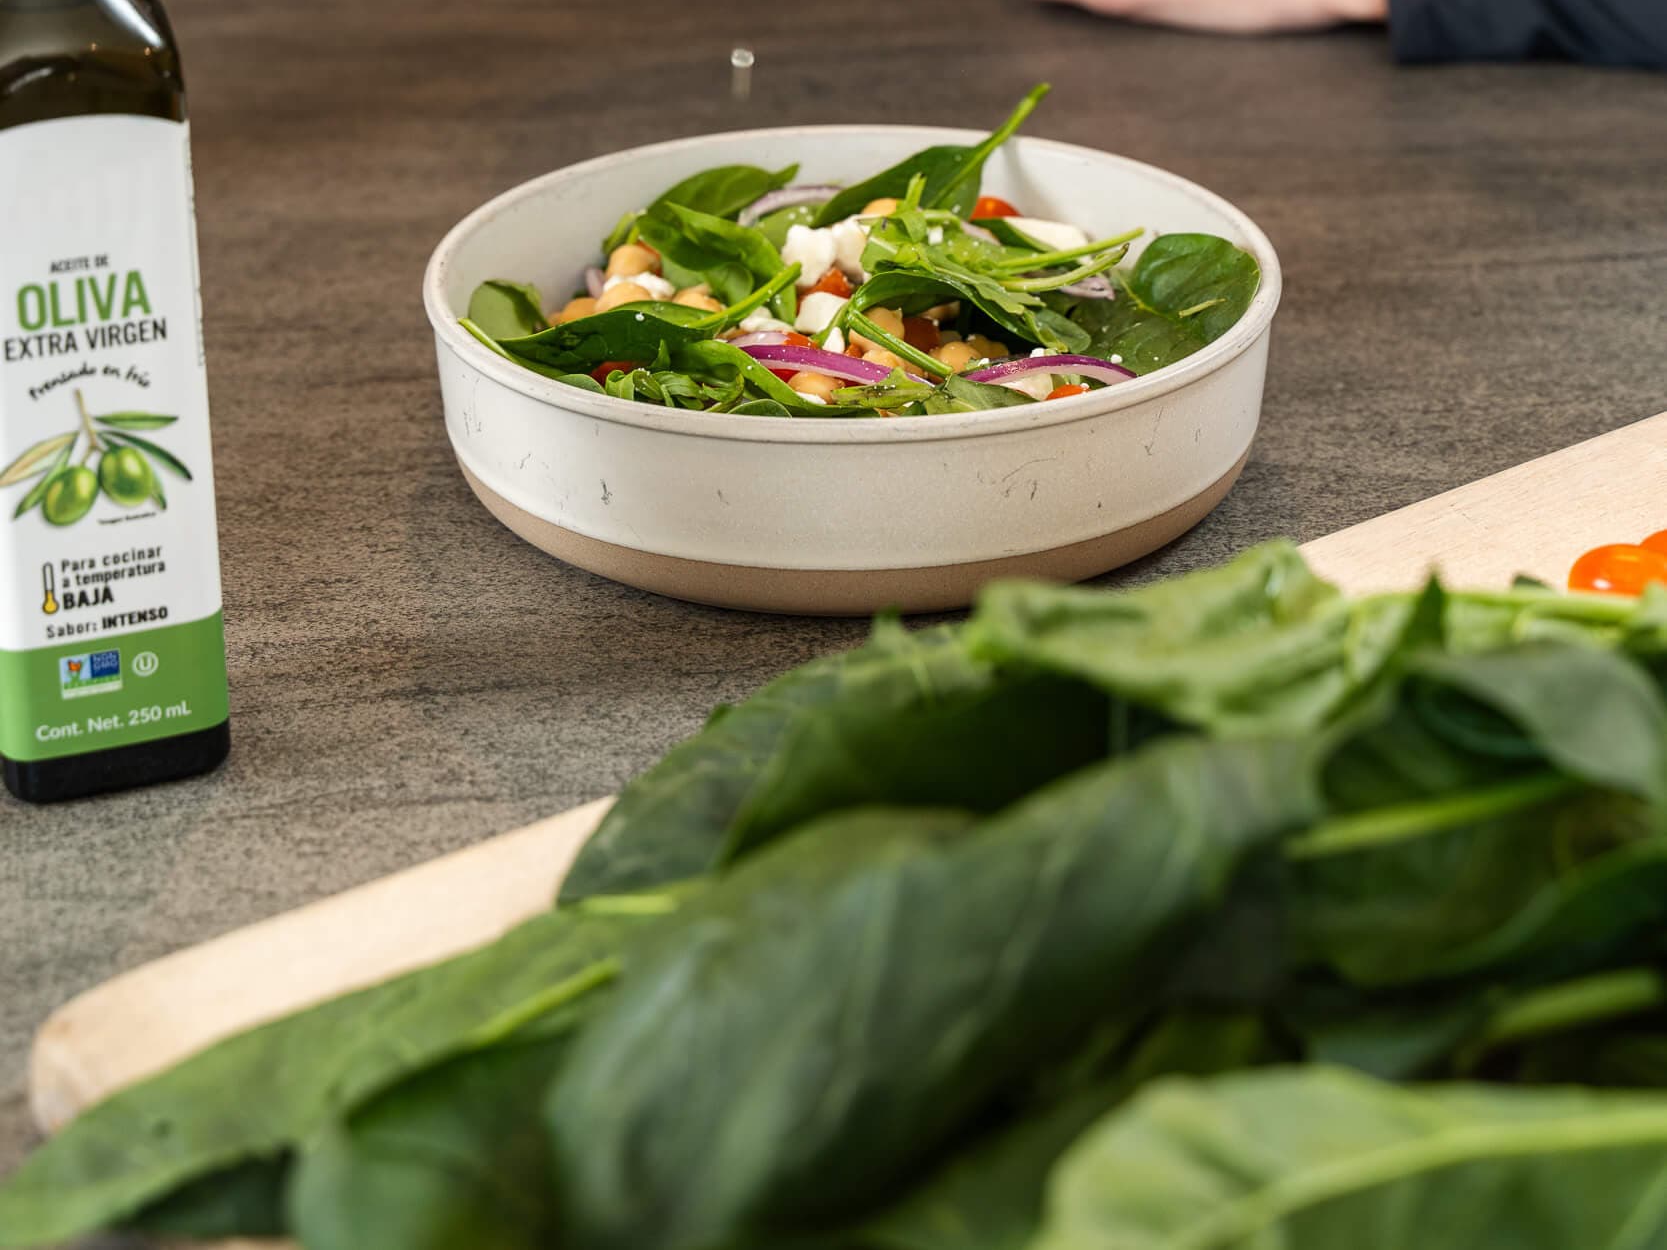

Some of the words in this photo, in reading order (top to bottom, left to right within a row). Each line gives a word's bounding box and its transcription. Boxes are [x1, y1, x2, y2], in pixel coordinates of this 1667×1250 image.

[50, 256, 90, 273] ACEITE
[94, 254, 108, 268] DE
[17, 269, 152, 332] OLIVA
[4, 331, 78, 361] EXTRA
[86, 318, 167, 349] VIRGEN
[61, 558, 96, 572] Para
[102, 545, 162, 566] cocinar
[62, 577, 70, 588] a
[76, 561, 166, 585] temperatura
[62, 584, 114, 610] BAJA
[46, 622, 98, 639] Sabor:
[101, 605, 168, 630] INTENSO
[35, 721, 83, 742] Cont.
[87, 714, 124, 733] Net.
[128, 705, 162, 726] 250
[165, 700, 192, 718] mL
